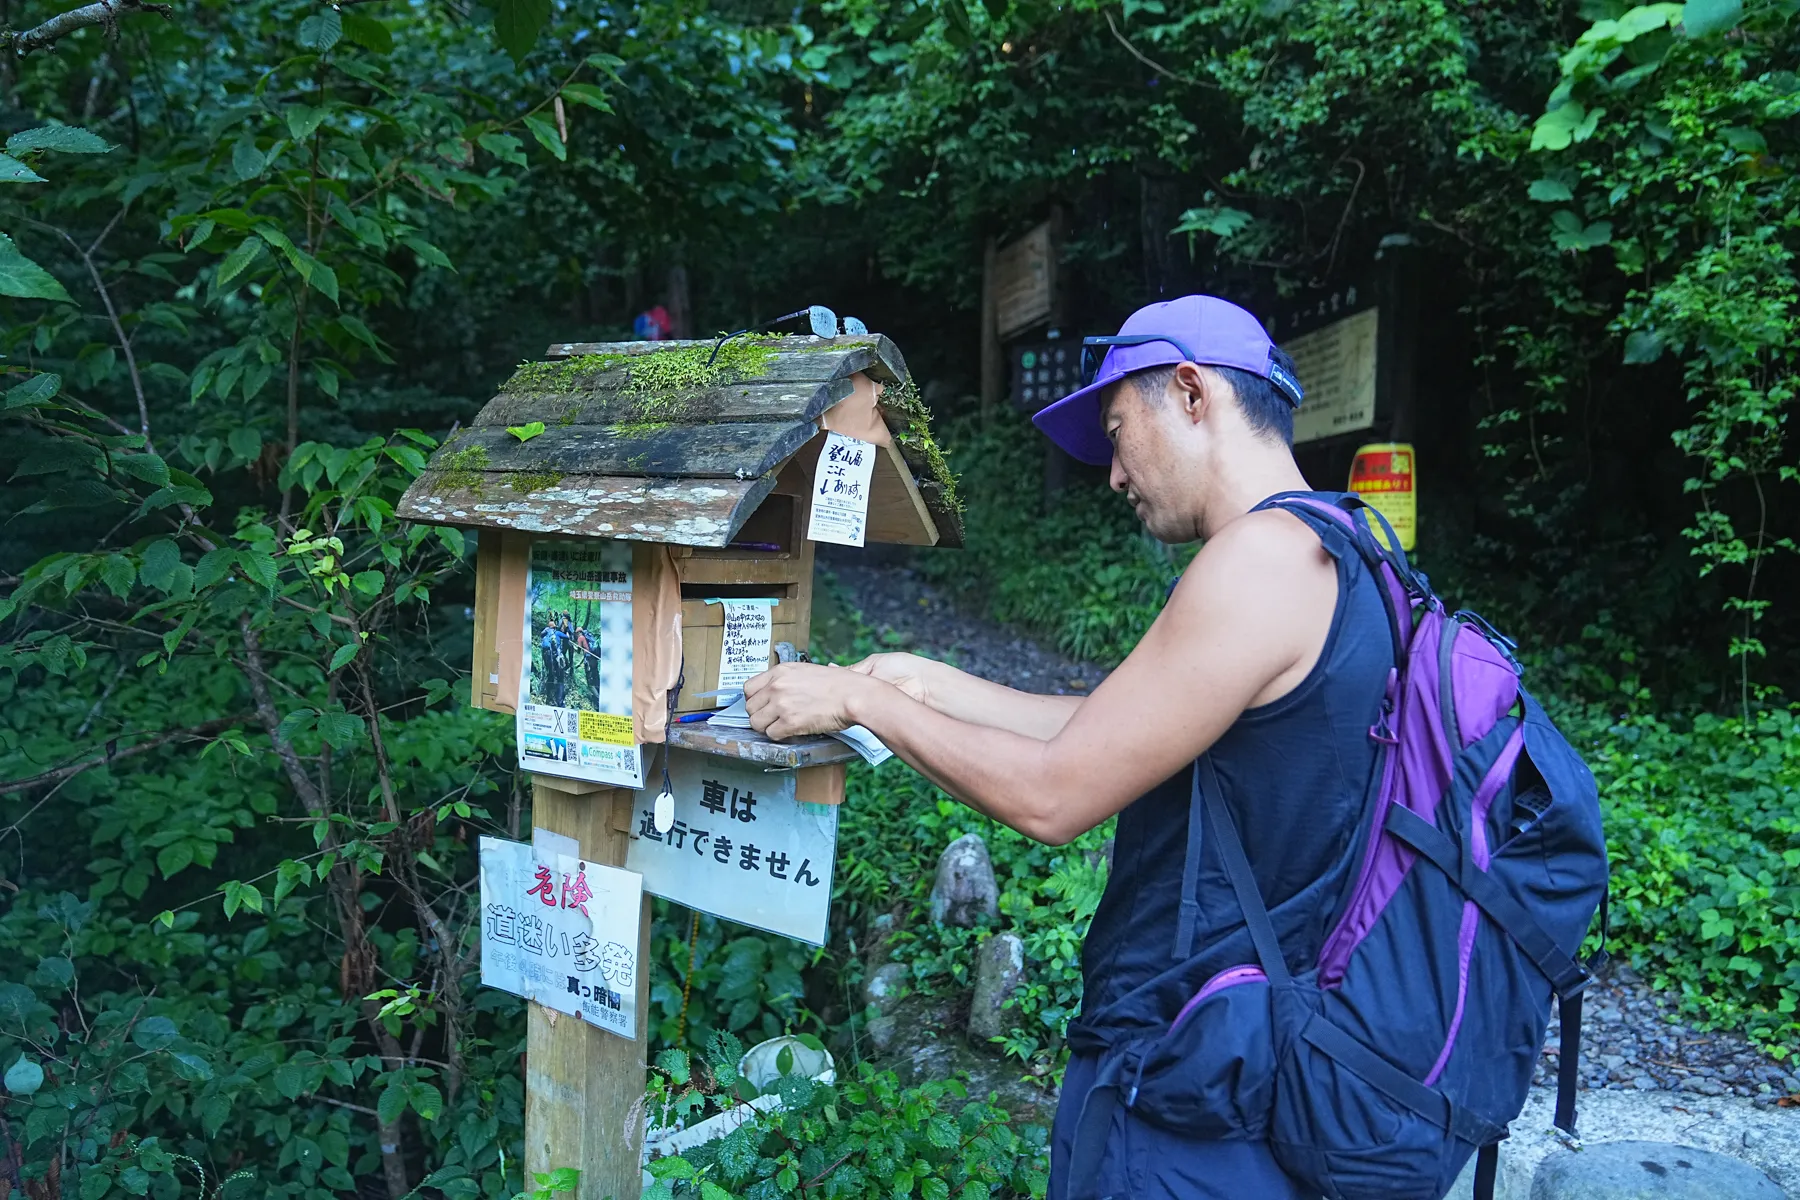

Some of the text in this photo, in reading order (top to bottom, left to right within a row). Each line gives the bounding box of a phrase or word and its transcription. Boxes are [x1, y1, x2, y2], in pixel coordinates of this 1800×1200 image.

[828, 444, 863, 466] 登山届
[588, 747, 614, 760] Compass
[700, 779, 757, 823] 車は
[639, 810, 820, 887] 通行できません
[527, 865, 593, 917] 危険
[487, 903, 634, 987] 道迷い多発
[582, 1001, 627, 1028] 飯能警察署
